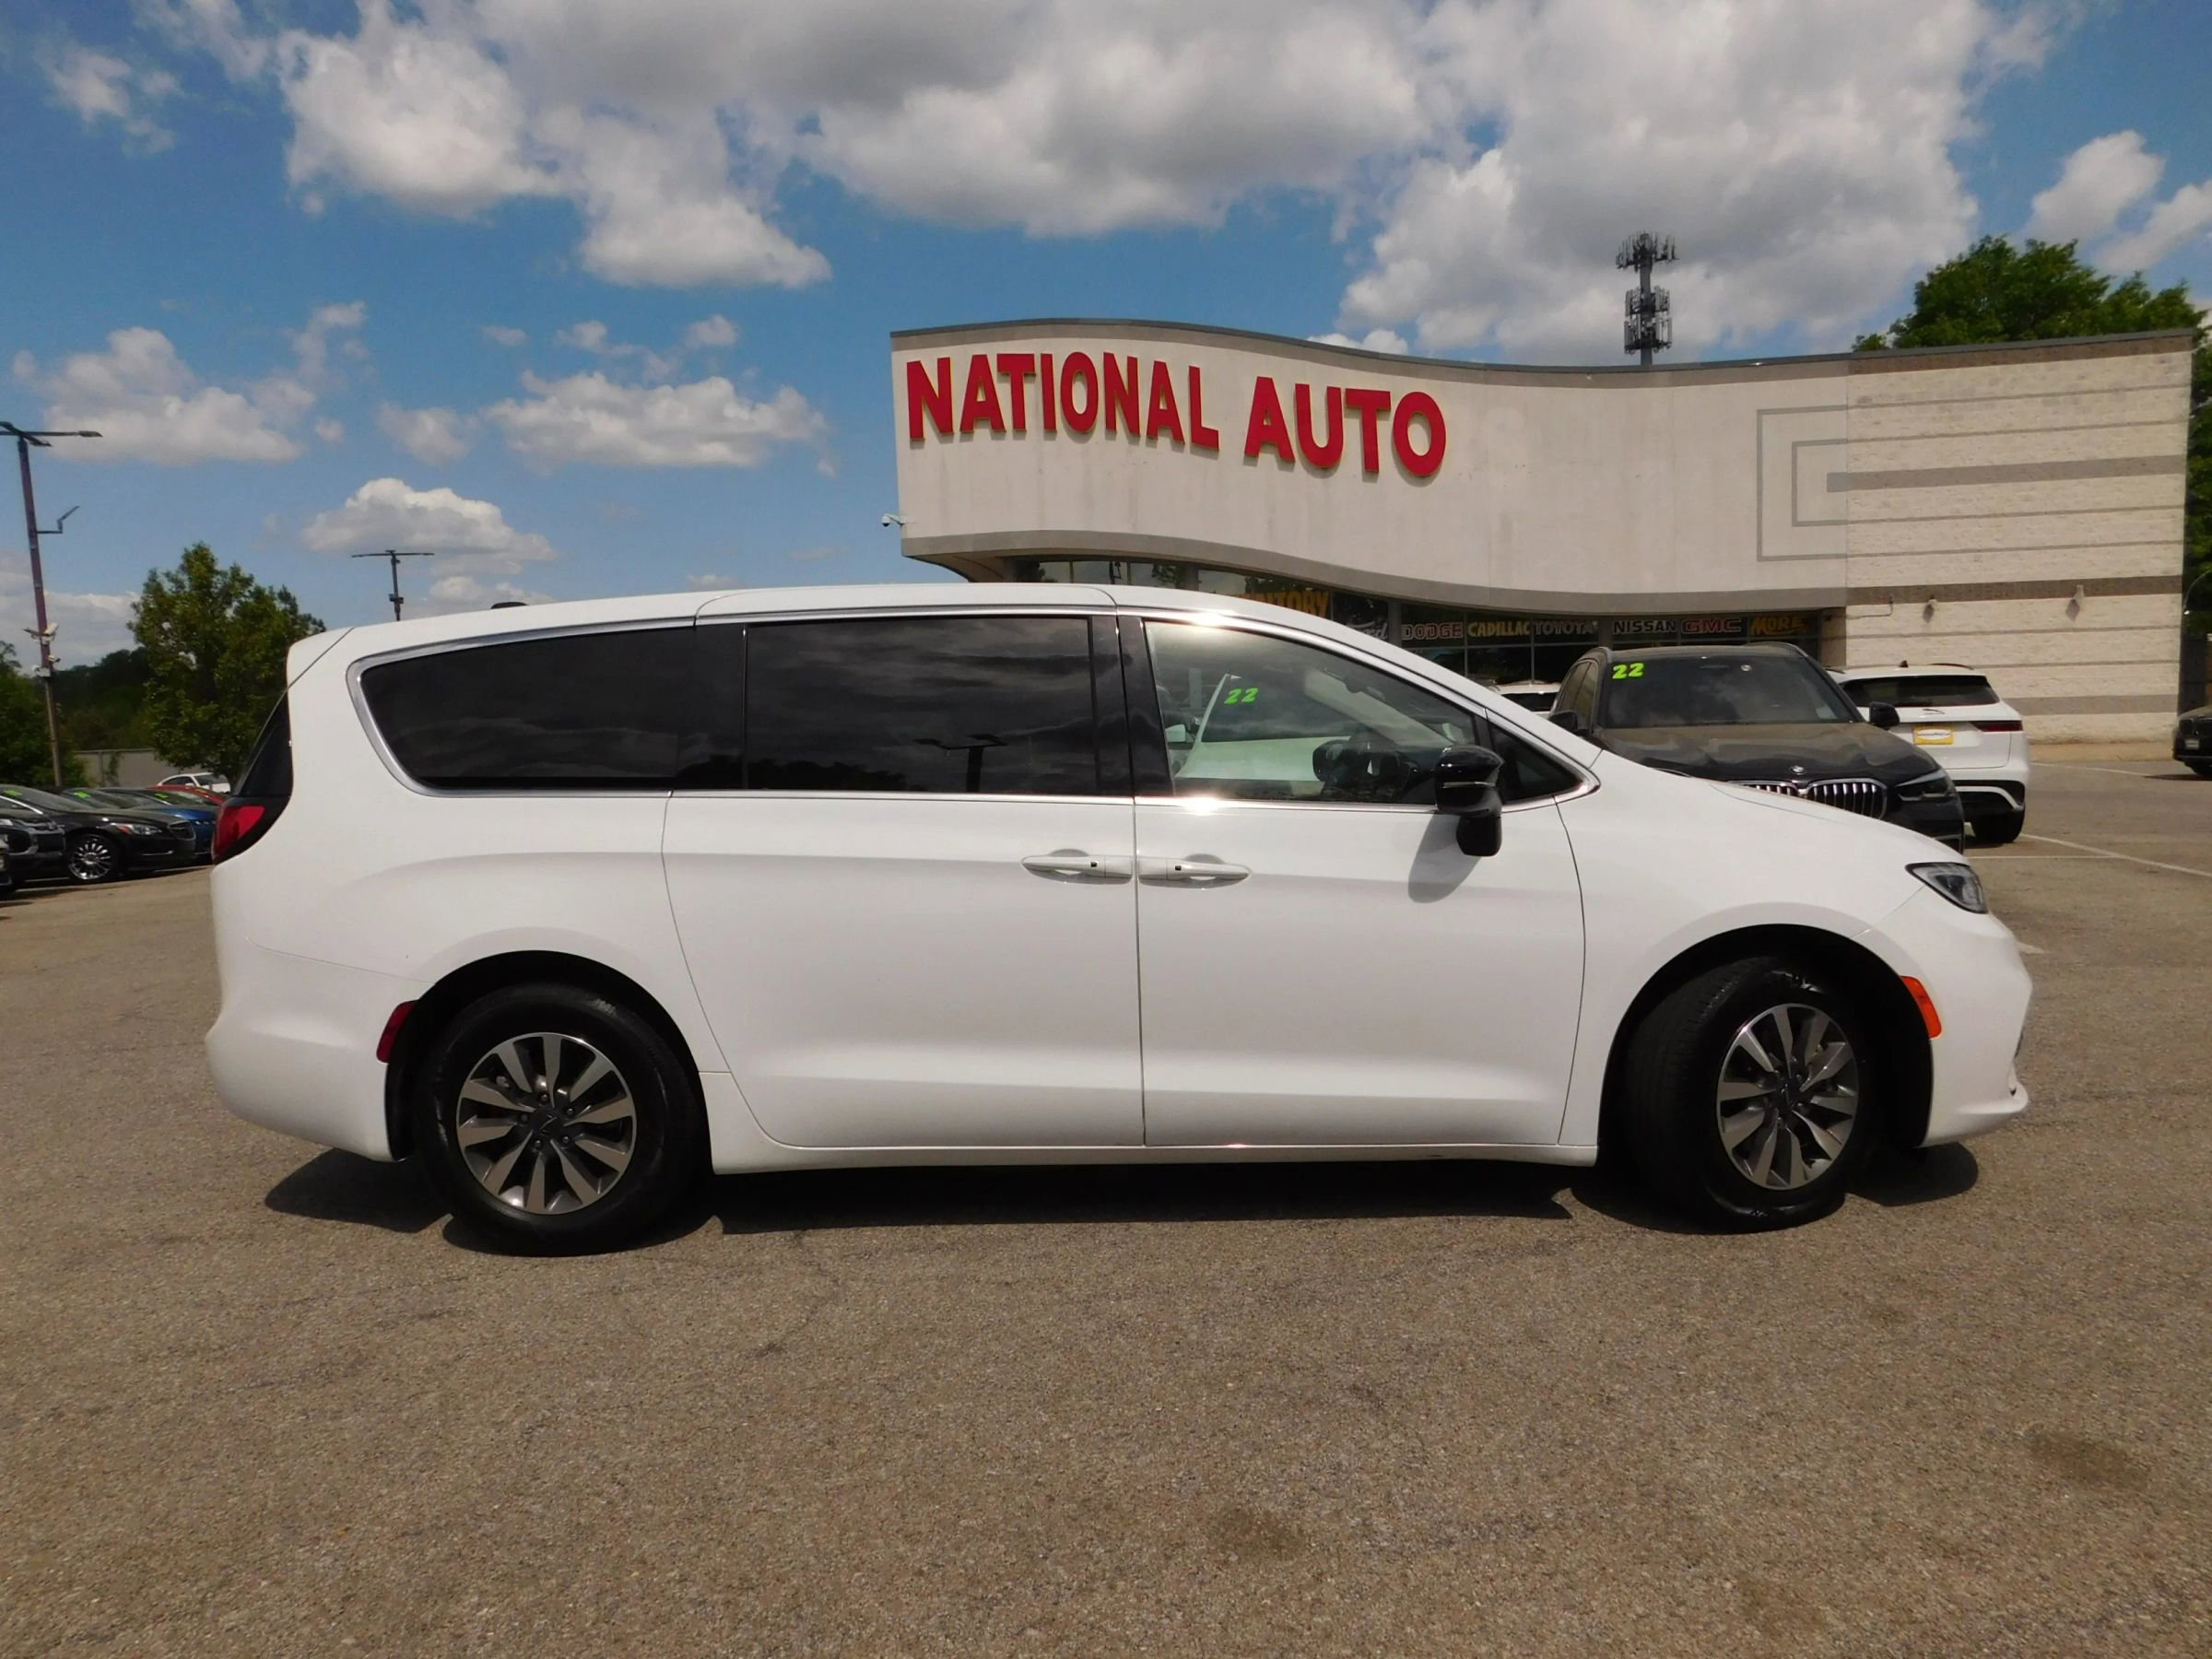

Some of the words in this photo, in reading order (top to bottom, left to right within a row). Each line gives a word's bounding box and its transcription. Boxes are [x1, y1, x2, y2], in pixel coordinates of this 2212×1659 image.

[906, 351, 1219, 451] NATIONAL
[1244, 376, 1447, 477] AUTO
[1401, 621, 1464, 641] DODGE
[1467, 620, 1532, 637] CADILLAC
[1533, 619, 1594, 635] TOYOTA
[1613, 619, 1677, 634] NISSAN
[1680, 618, 1743, 634] GMC
[1751, 616, 1805, 634] MORE
[1613, 663, 1644, 679] 22
[1224, 688, 1259, 705] 22
